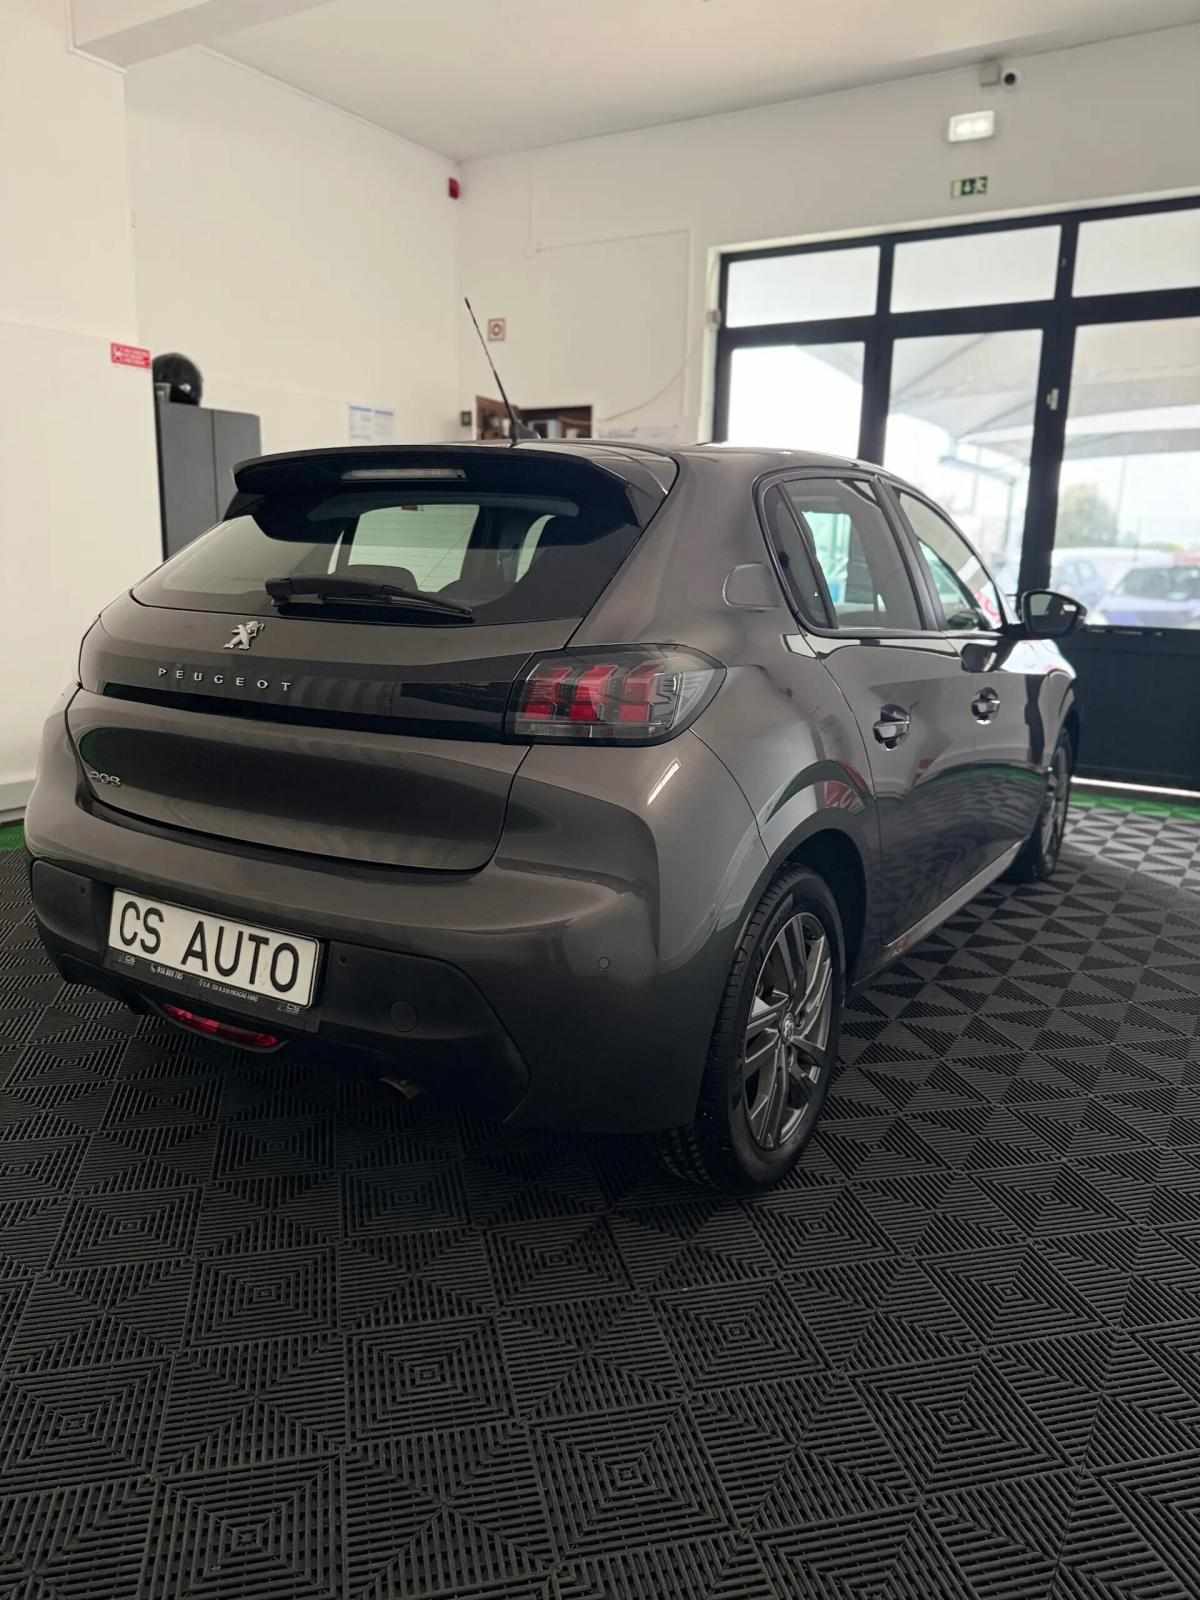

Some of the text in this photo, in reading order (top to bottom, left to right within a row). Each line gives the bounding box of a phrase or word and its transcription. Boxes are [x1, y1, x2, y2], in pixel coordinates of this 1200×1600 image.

[157, 666, 292, 692] PEUGEOT
[119, 900, 300, 993] CS AUTO
